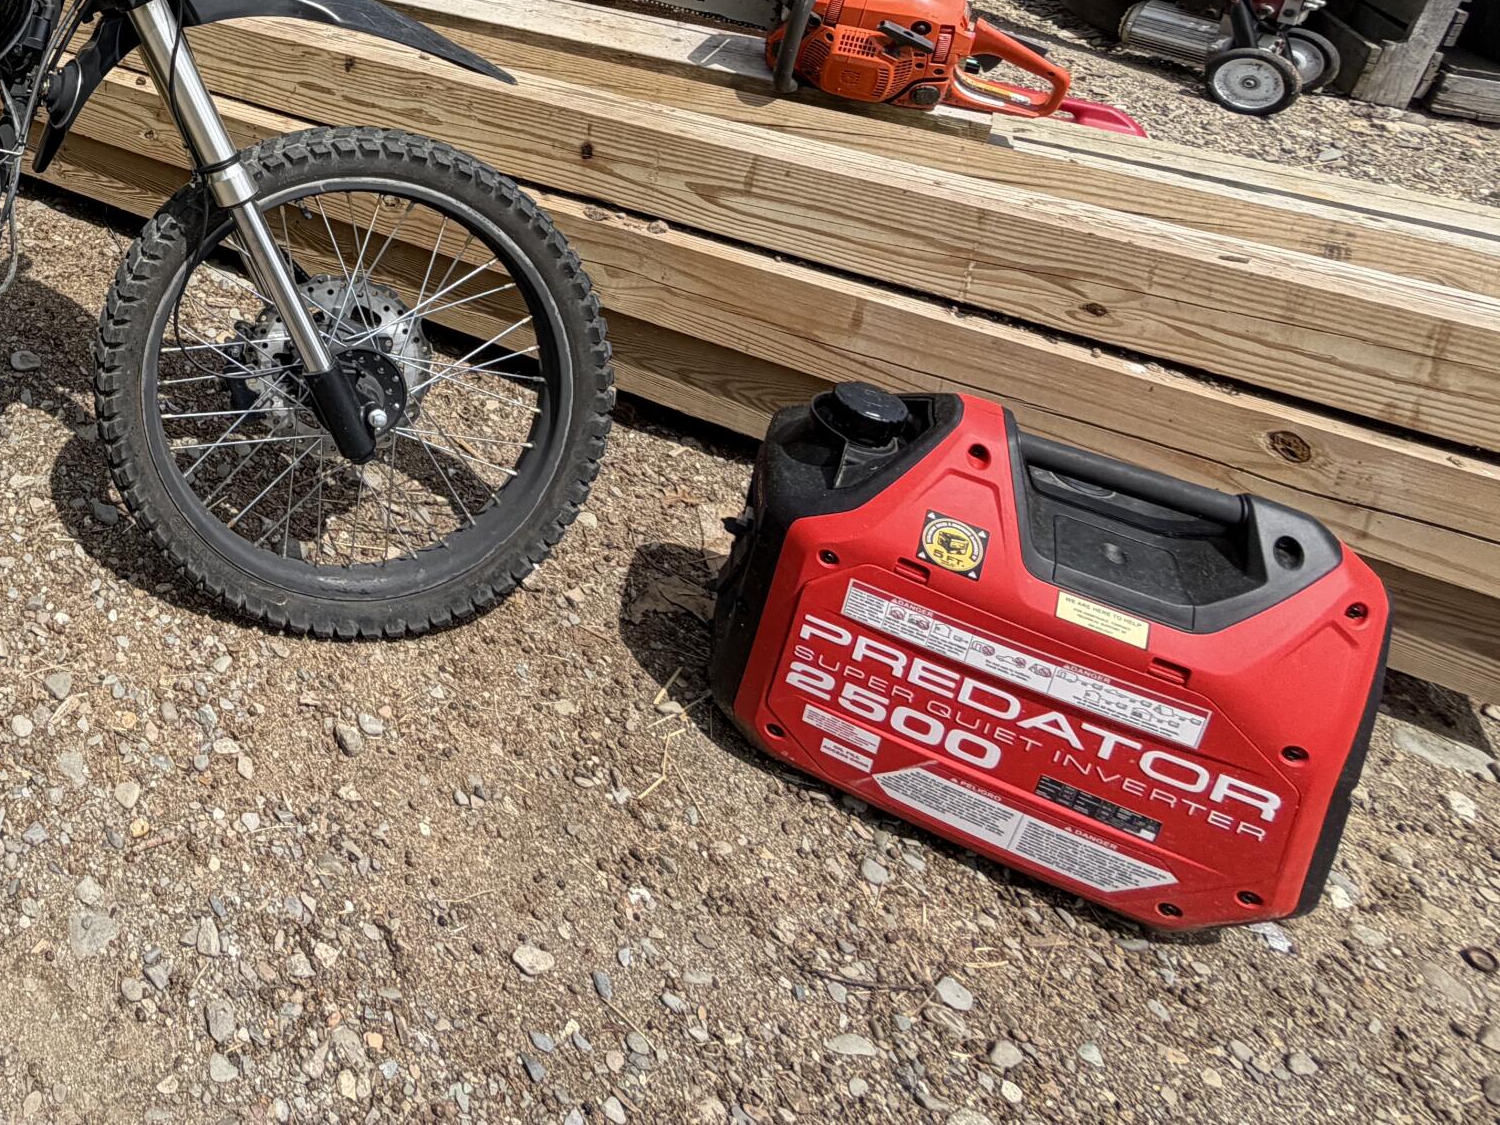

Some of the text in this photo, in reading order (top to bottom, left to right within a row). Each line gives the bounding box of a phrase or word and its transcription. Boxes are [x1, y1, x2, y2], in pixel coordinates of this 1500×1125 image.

[896, 598, 934, 618] DANGER
[1070, 665, 1112, 684] DANGER
[785, 661, 1002, 770] 2500
[800, 614, 1282, 822] PREDATOR
[794, 644, 915, 703] SUPER
[926, 700, 1043, 752] QUIET
[1053, 750, 1267, 842] INVERTER
[960, 780, 1002, 803] PELIGRO
[1074, 828, 1119, 851] DANGER
